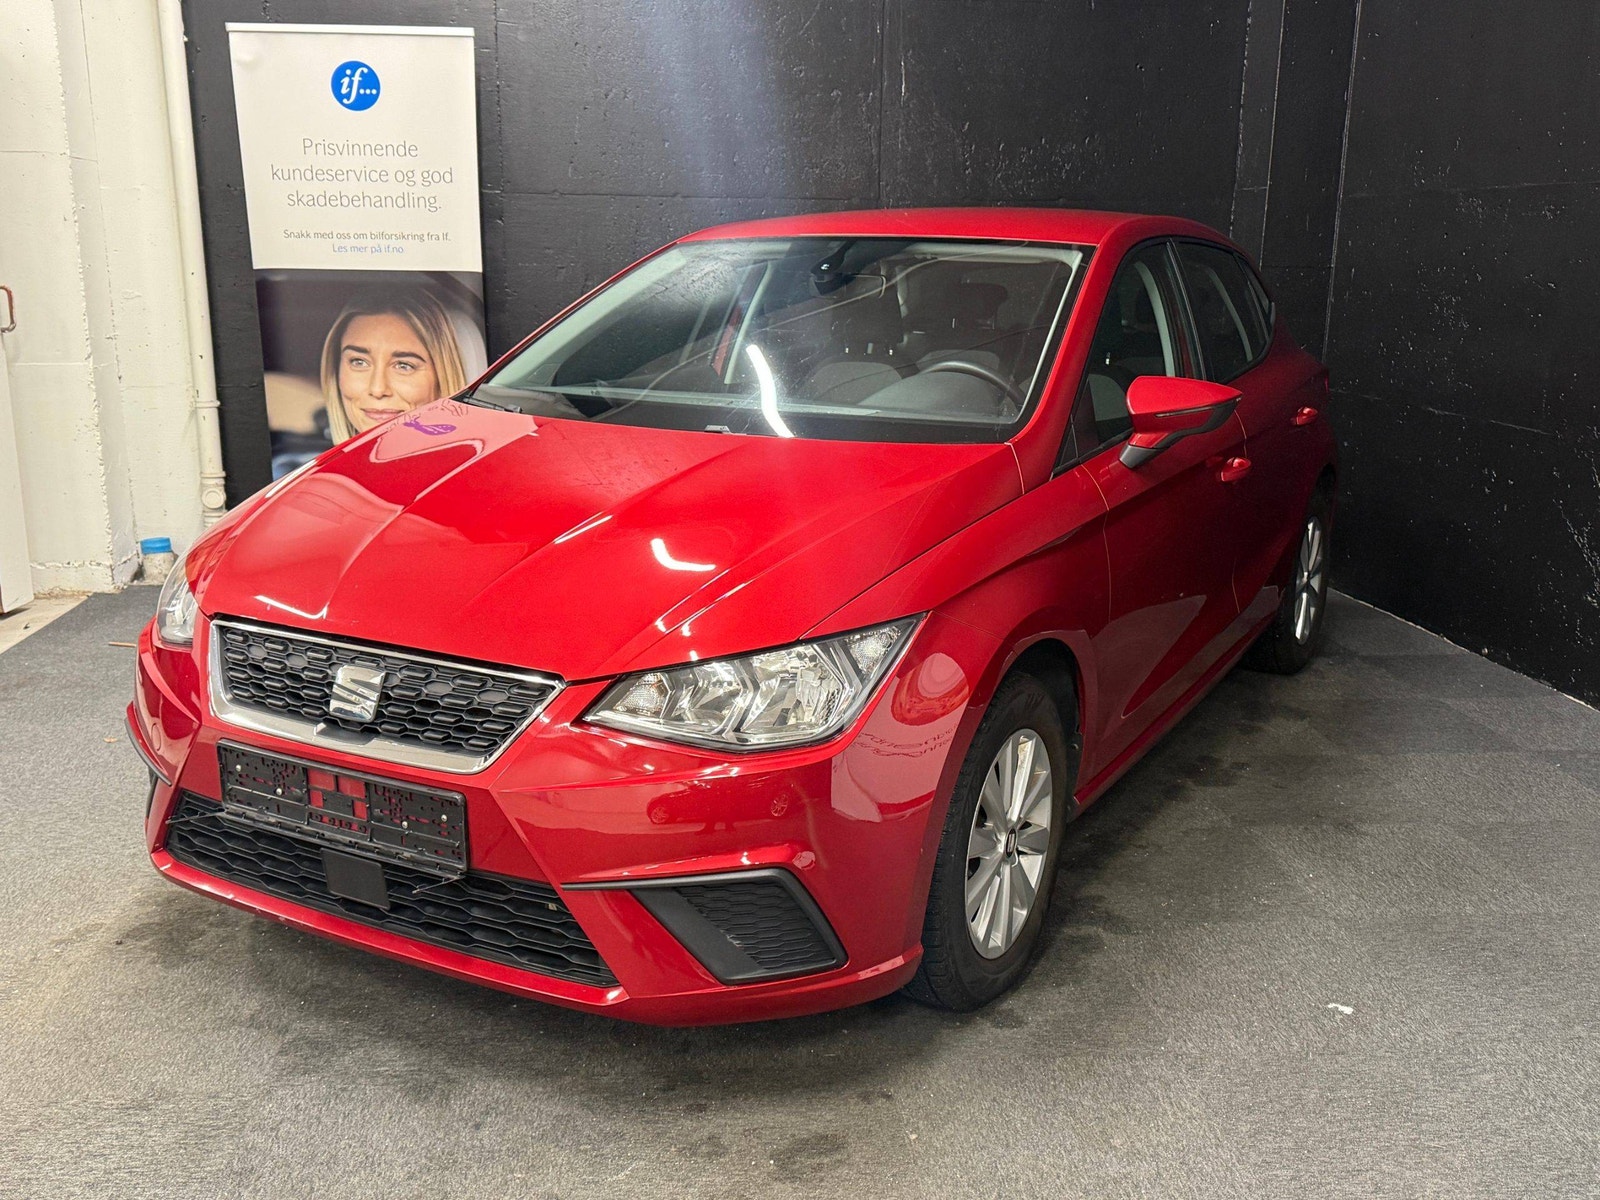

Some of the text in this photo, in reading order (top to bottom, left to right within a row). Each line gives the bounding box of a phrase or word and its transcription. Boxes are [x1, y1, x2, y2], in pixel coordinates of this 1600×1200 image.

[302, 137, 418, 158] Prisvinnende
[271, 164, 454, 188] kundeservice og god
[287, 190, 442, 213] skadebehandling.
[283, 229, 312, 240] Snakk
[313, 230, 334, 240] med
[336, 232, 351, 240] oss
[353, 232, 368, 240] om
[369, 231, 425, 243] bilforsikring
[427, 232, 440, 241] fra
[332, 243, 404, 255] Les mer på if.no
